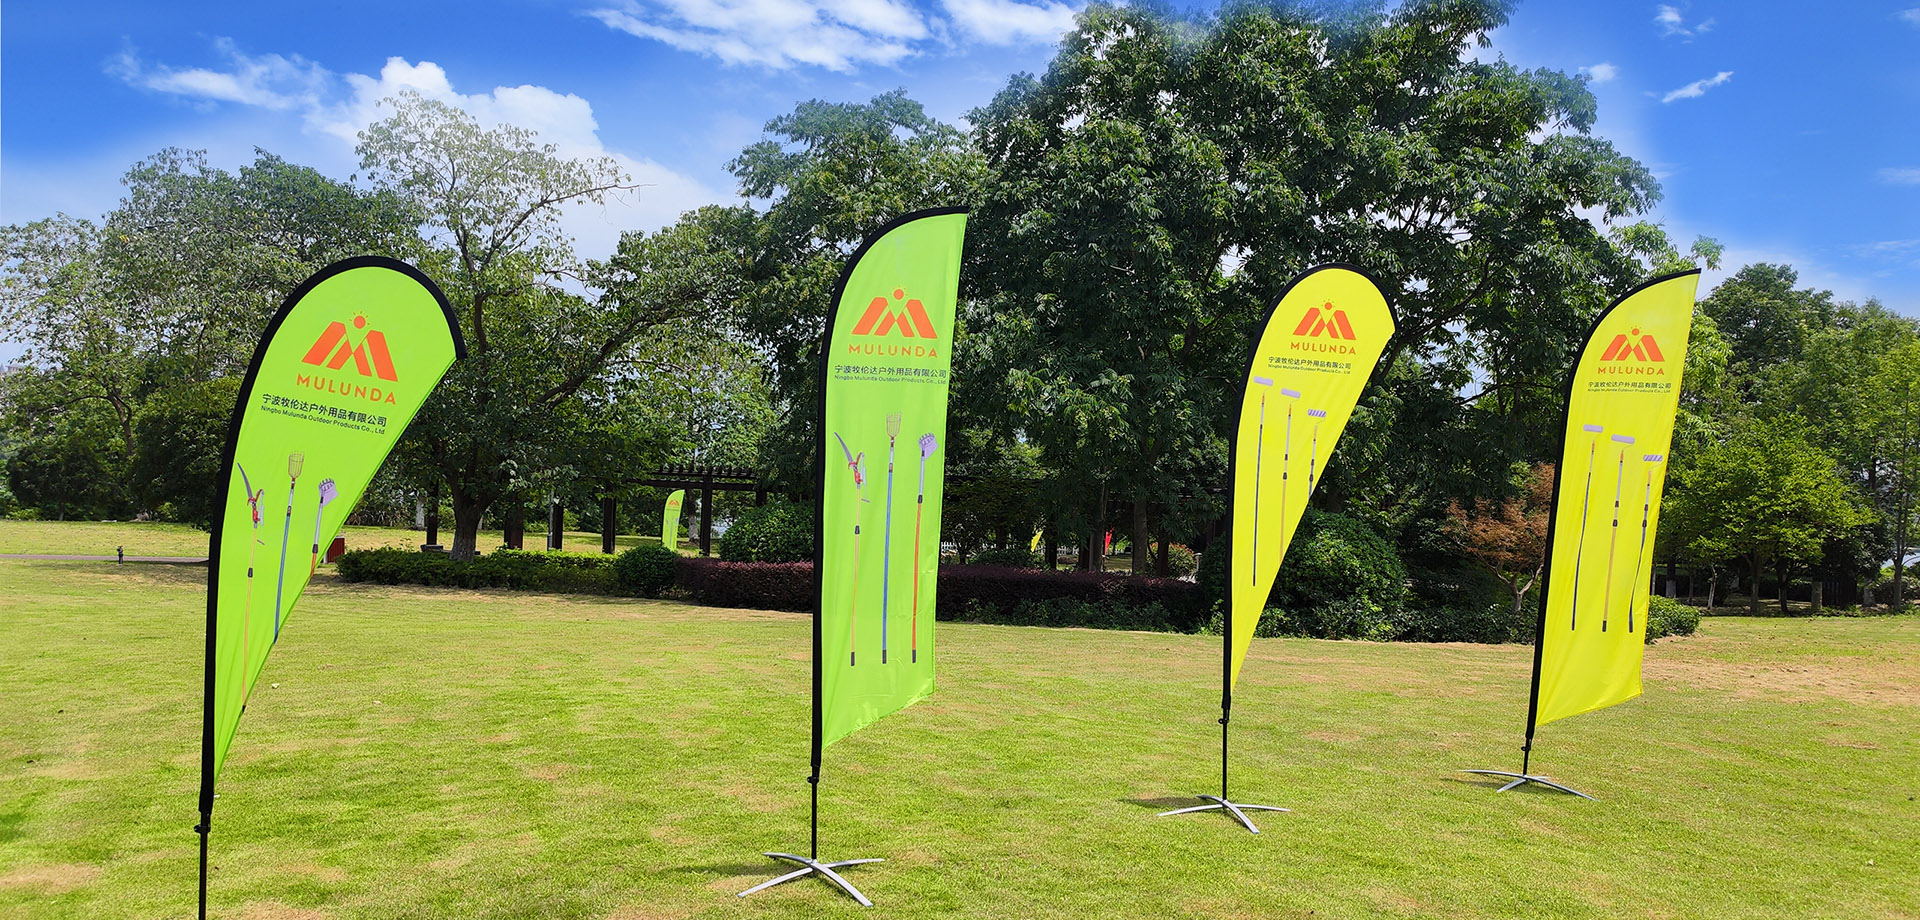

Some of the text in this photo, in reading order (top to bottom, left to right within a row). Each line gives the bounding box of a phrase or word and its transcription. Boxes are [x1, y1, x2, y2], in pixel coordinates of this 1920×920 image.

[848, 344, 938, 357] MULUNDA
[1290, 342, 1356, 355] MULUNDA
[835, 365, 947, 378] 宁波牧伦达户外用品有限公司
[1597, 367, 1665, 375] MULUNDA
[297, 373, 396, 405] MULUNDA
[262, 393, 387, 427] 宁波牧伦达户外用品有限公司
[261, 405, 281, 415] Ningbo
[282, 409, 307, 420] Mulunda
[308, 414, 332, 425] Outdoor
[333, 420, 360, 430] Products
